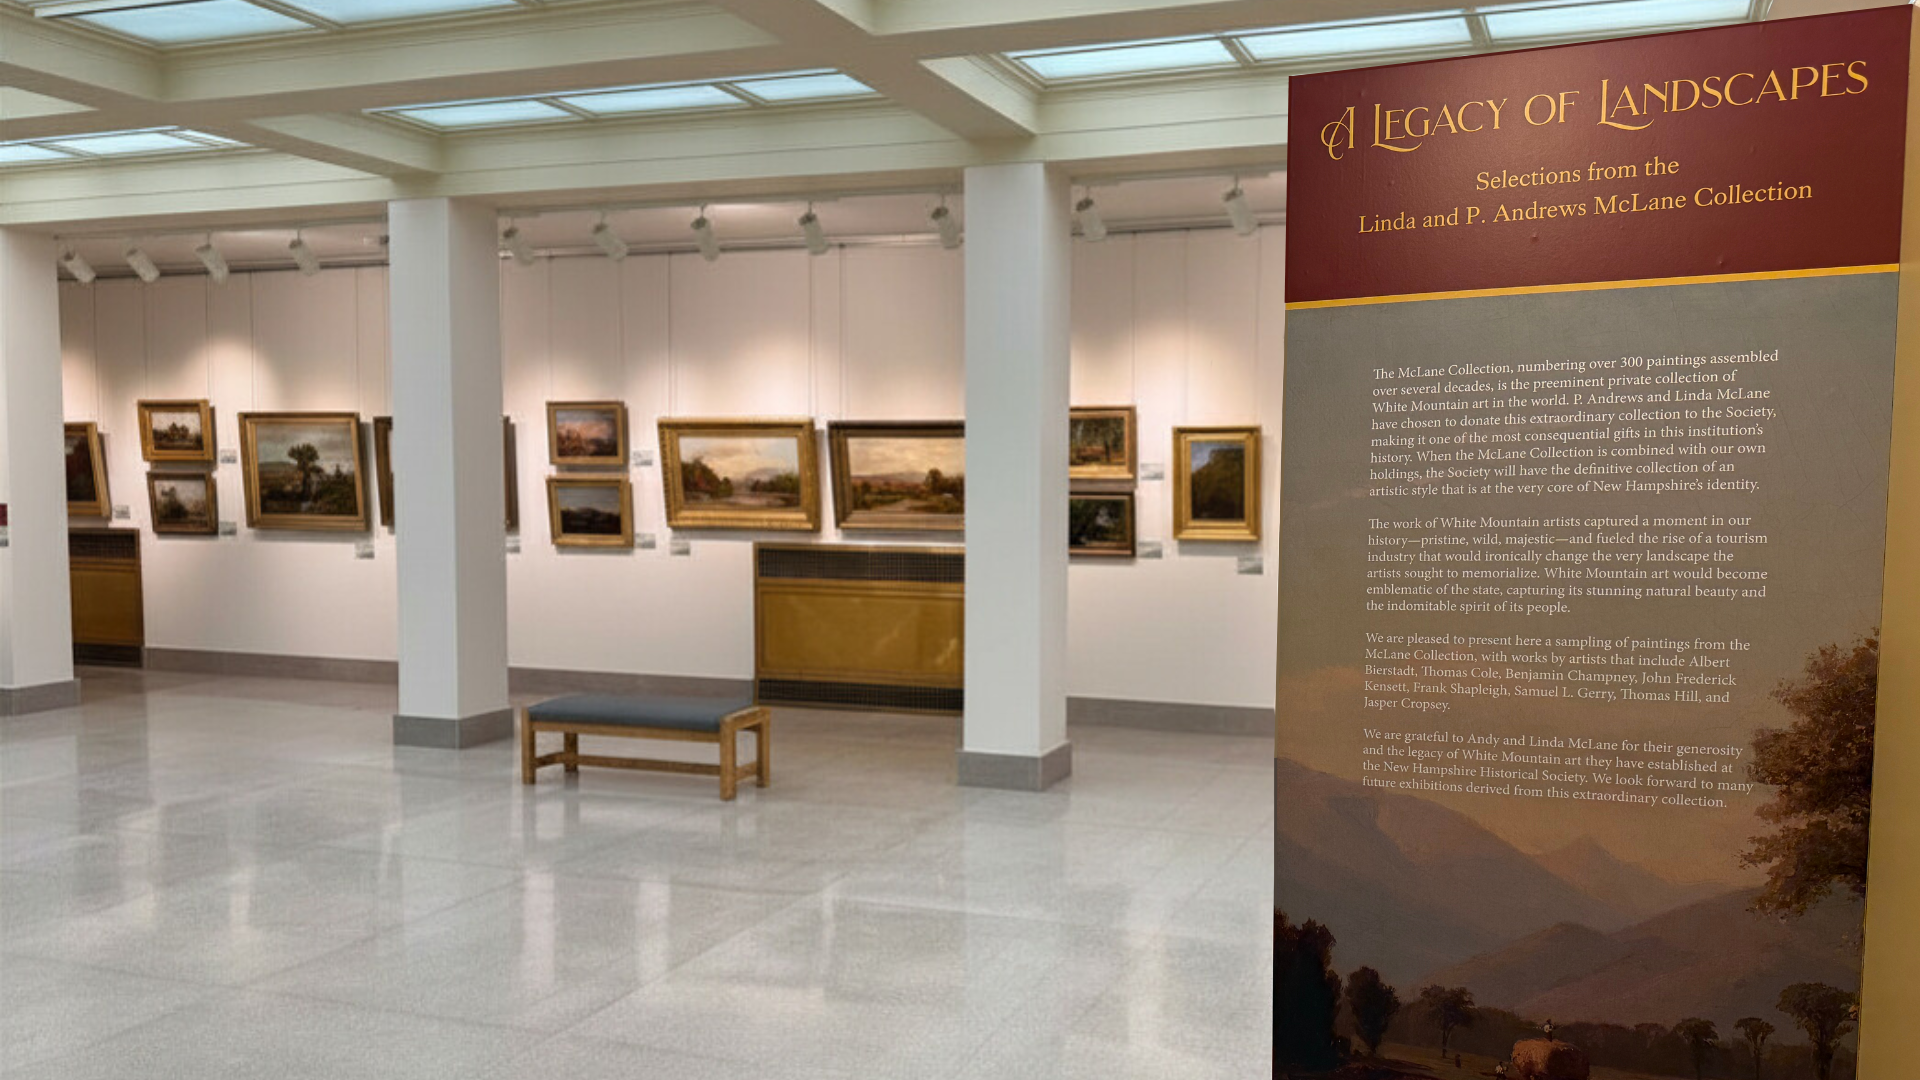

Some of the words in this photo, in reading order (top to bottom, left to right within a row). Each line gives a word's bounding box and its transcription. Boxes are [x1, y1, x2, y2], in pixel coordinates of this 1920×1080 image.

[1321, 107, 1354, 159] A
[1371, 98, 1508, 152] LEGACY
[1524, 91, 1579, 125] OF
[1597, 61, 1867, 130] LANDSCAPES
[1477, 167, 1580, 190] Selections
[1588, 162, 1637, 181] from
[1645, 156, 1679, 175] the
[1359, 212, 1415, 233] Linda
[1423, 207, 1458, 227] and
[1466, 207, 1485, 224] P.
[1493, 201, 1586, 222] Andrews
[1594, 193, 1686, 214] McLane
[1695, 182, 1812, 206] Collection
[1373, 368, 1395, 379] The
[1398, 366, 1445, 378] McLane
[1448, 363, 1514, 375] Collection,
[1517, 359, 1586, 373] numbering
[1589, 360, 1617, 369] over
[1620, 356, 1643, 368] 300
[1646, 354, 1706, 370] paintings
[1710, 349, 1779, 364] assembled
[1372, 387, 1398, 397] over
[1401, 382, 1440, 395] several
[1444, 380, 1494, 393] decades,
[1497, 380, 1507, 390] is
[1511, 378, 1530, 390] the
[1533, 376, 1604, 392] preeminent
[1607, 374, 1652, 390] private
[1655, 371, 1718, 384] collection
[1722, 369, 1738, 382] of
[1372, 401, 1408, 413] White
[1410, 399, 1468, 412] Mountain
[1472, 399, 1489, 409] art
[1492, 397, 1504, 408] in
[1508, 395, 1527, 407] the
[1530, 394, 1569, 406] world.
[1573, 394, 1583, 405] P.
[1587, 392, 1643, 404] Andrews
[1647, 390, 1671, 402] and
[1674, 388, 1712, 401] Linda
[1716, 387, 1771, 400] McLane
[1370, 452, 1412, 466] history.
[1416, 450, 1452, 462] When
[1455, 449, 1474, 460] the
[1477, 449, 1526, 460] McLane
[1529, 446, 1594, 458] Collection
[1597, 446, 1607, 457] is
[1611, 443, 1674, 457] combined
[1678, 442, 1706, 455] with
[1710, 445, 1734, 454] our
[1737, 445, 1766, 453] own
[1370, 468, 1422, 482] holdings,
[1426, 467, 1444, 478] the
[1447, 466, 1491, 480] Society
[1494, 464, 1516, 476] will
[1519, 464, 1548, 476] have
[1551, 463, 1571, 475] the
[1574, 462, 1632, 475] definitive
[1636, 461, 1698, 473] collection
[1702, 460, 1718, 472] of
[1719, 463, 1734, 472] an
[1368, 550, 1416, 565] industry
[1419, 550, 1441, 562] that
[1445, 550, 1481, 561] would
[1485, 550, 1542, 565] ironically
[1545, 550, 1589, 565] change
[1592, 550, 1612, 561] the
[1615, 553, 1643, 565] very
[1646, 549, 1710, 565] landscape
[1713, 549, 1734, 561] the
[1367, 568, 1401, 578] artists
[1404, 567, 1444, 581] sought
[1447, 569, 1458, 578] to
[1462, 567, 1540, 578] memorialize.
[1544, 566, 1582, 578] White
[1585, 567, 1647, 579] Mountain
[1651, 569, 1669, 579] art
[1672, 567, 1713, 579] would
[1717, 567, 1768, 579] become
[1366, 583, 1433, 595] emblematic
[1436, 583, 1449, 595] of
[1451, 583, 1470, 595] the
[1472, 586, 1503, 596] state,
[1506, 585, 1565, 599] capturing
[1568, 585, 1583, 596] its
[1586, 585, 1642, 600] stunning
[1646, 585, 1691, 596] natural
[1695, 585, 1738, 601] beauty
[1741, 585, 1766, 598] and
[1366, 599, 1384, 611] the
[1387, 600, 1457, 611] indomitable
[1459, 601, 1490, 614] spirit
[1494, 600, 1508, 612] of
[1509, 601, 1524, 612] its
[1526, 601, 1570, 616] people.
[1365, 648, 1411, 660] McLane
[1413, 649, 1477, 662] Collection,
[1481, 651, 1507, 662] with
[1511, 651, 1548, 663] works
[1551, 652, 1566, 667] by
[1569, 653, 1607, 664] artists
[1611, 653, 1634, 665] that
[1638, 654, 1685, 666] include
[1689, 655, 1730, 668] Albert
[1365, 664, 1418, 677] Bierstadt,
[1421, 666, 1468, 677] Thomas
[1471, 667, 1502, 679] Cole,
[1505, 668, 1563, 683] Benjamin
[1567, 670, 1638, 686] Champney,
[1642, 671, 1671, 684] John
[1675, 673, 1737, 686] Frederick
[1364, 680, 1410, 693] Kensett,
[1413, 682, 1447, 693] Frank
[1450, 683, 1511, 699] Shapleigh,
[1514, 685, 1558, 697] Samuel
[1562, 687, 1573, 698] L.
[1577, 688, 1617, 702] Gerry,
[1620, 688, 1670, 701] Thomas
[1675, 690, 1702, 703] Hill,
[1705, 691, 1730, 703] and
[1364, 696, 1398, 710] Jasper
[1401, 698, 1450, 713] Cropsey.
[1363, 728, 1381, 739] We
[1384, 732, 1402, 740] are
[1404, 731, 1448, 744] grateful
[1452, 734, 1464, 743] to
[1467, 733, 1500, 748] Andy
[1503, 735, 1525, 746] and
[1529, 736, 1564, 748] Linda
[1568, 738, 1618, 750] McLane
[1621, 739, 1640, 751] for
[1643, 740, 1673, 753] their
[1676, 744, 1743, 759] generosity
[1363, 759, 1380, 771] the
[1383, 761, 1409, 772] New
[1413, 763, 1477, 778] Hampshire
[1480, 766, 1538, 780] Historical
[1542, 770, 1588, 786] Society.
[1592, 773, 1612, 784] We
[1615, 773, 1643, 786] look
[1647, 774, 1697, 789] forward
[1701, 780, 1713, 789] to
[1717, 782, 1754, 795] many
[1362, 775, 1396, 788] future
[1399, 778, 1463, 792] exhibitions
[1466, 781, 1510, 795] derived
[1514, 784, 1543, 797] from
[1547, 786, 1569, 799] this
[1572, 790, 1658, 807] extraordinary
[1661, 793, 1727, 808] collection.
